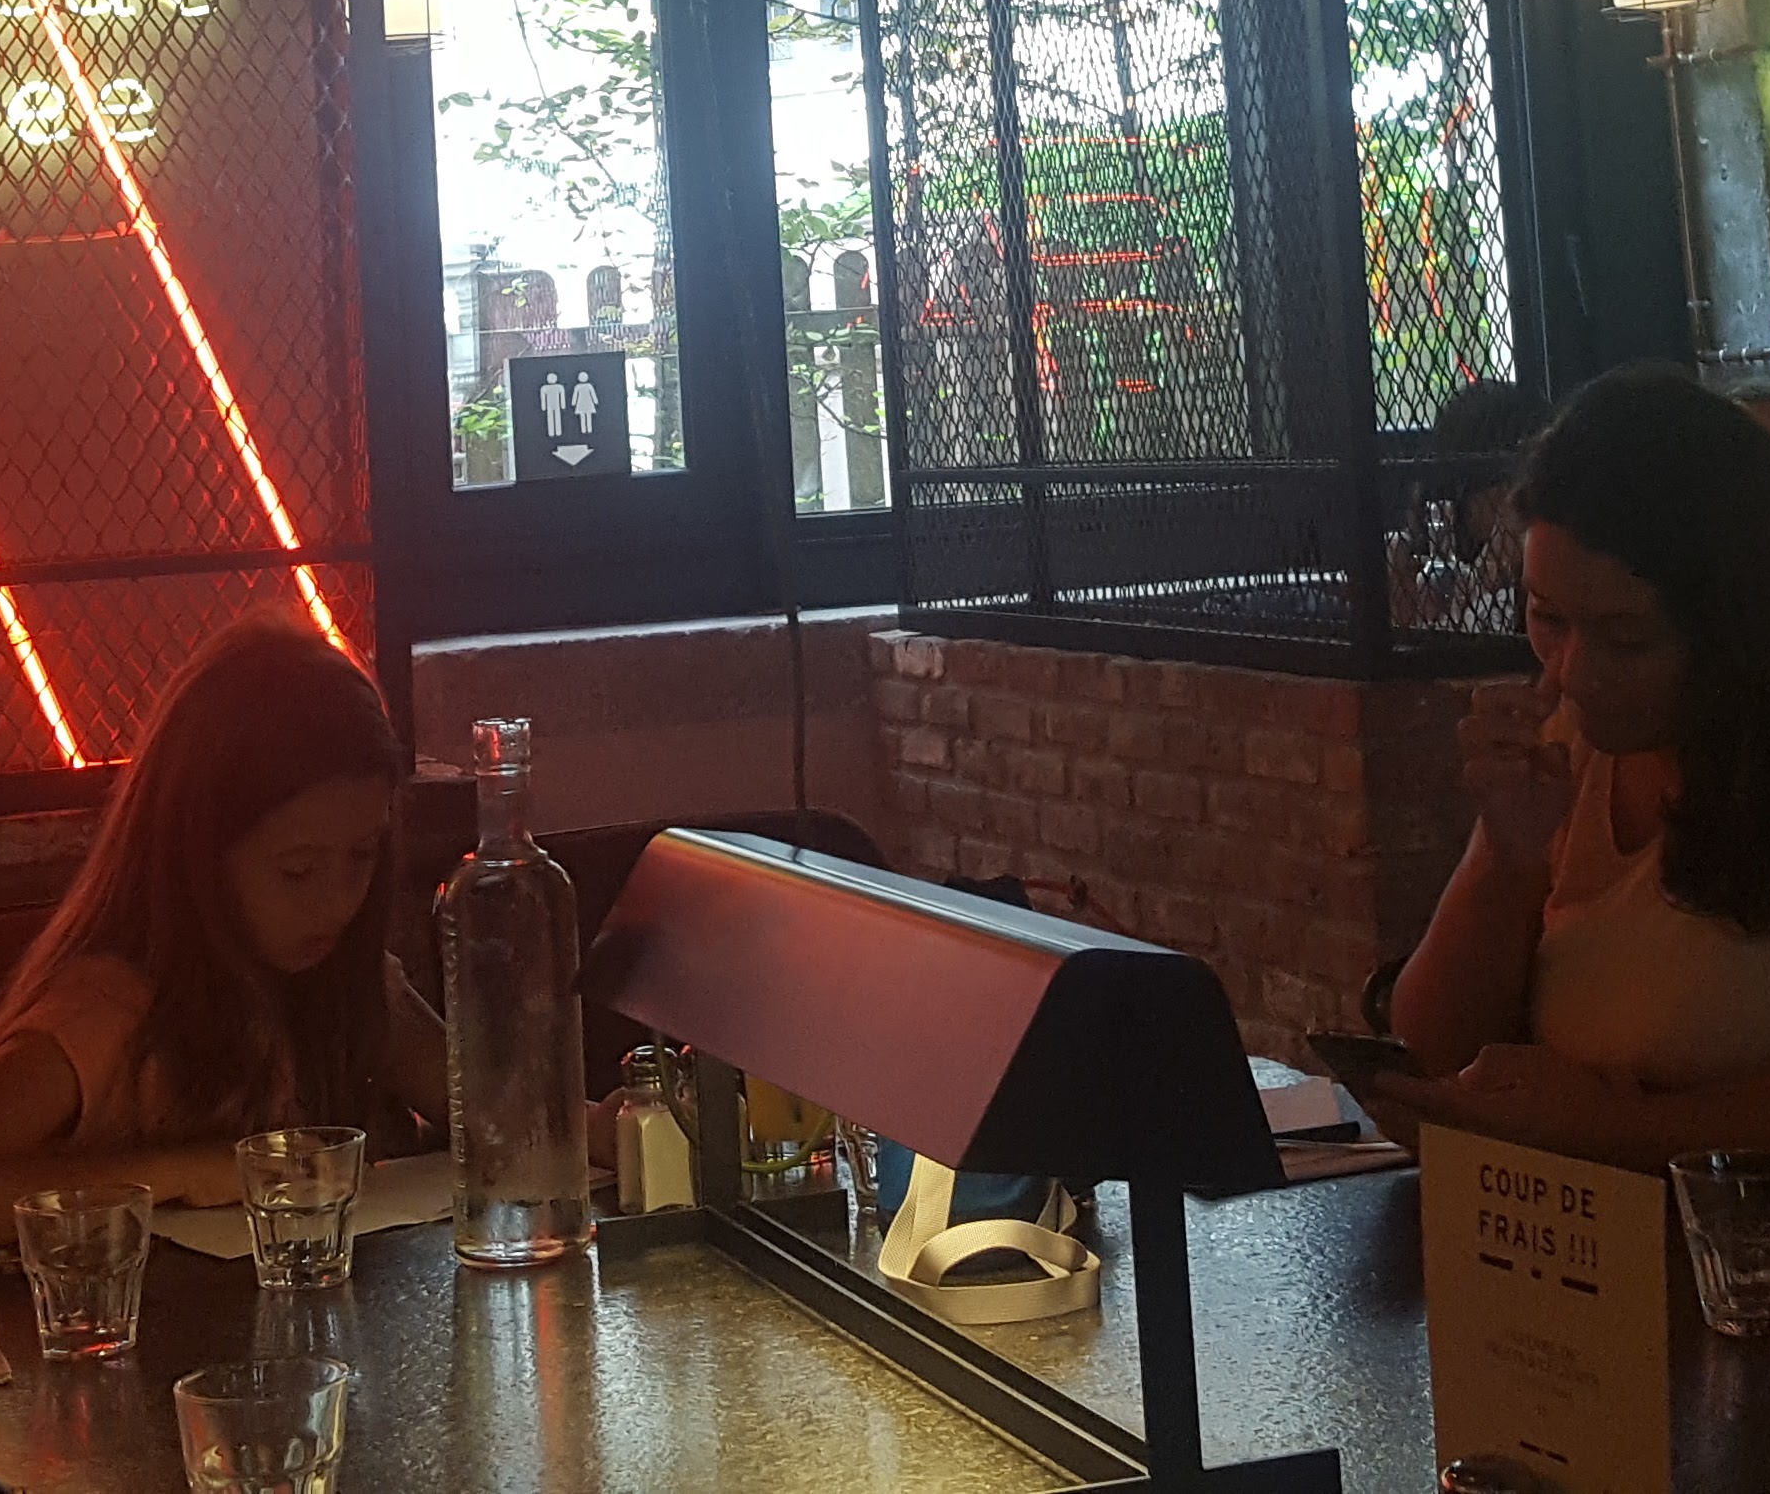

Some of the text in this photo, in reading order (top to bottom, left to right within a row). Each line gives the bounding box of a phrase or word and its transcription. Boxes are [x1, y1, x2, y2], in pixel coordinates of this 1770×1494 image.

[1480, 1164, 1597, 1221] COUP DE
[1478, 1210, 1557, 1256] FRAIS
